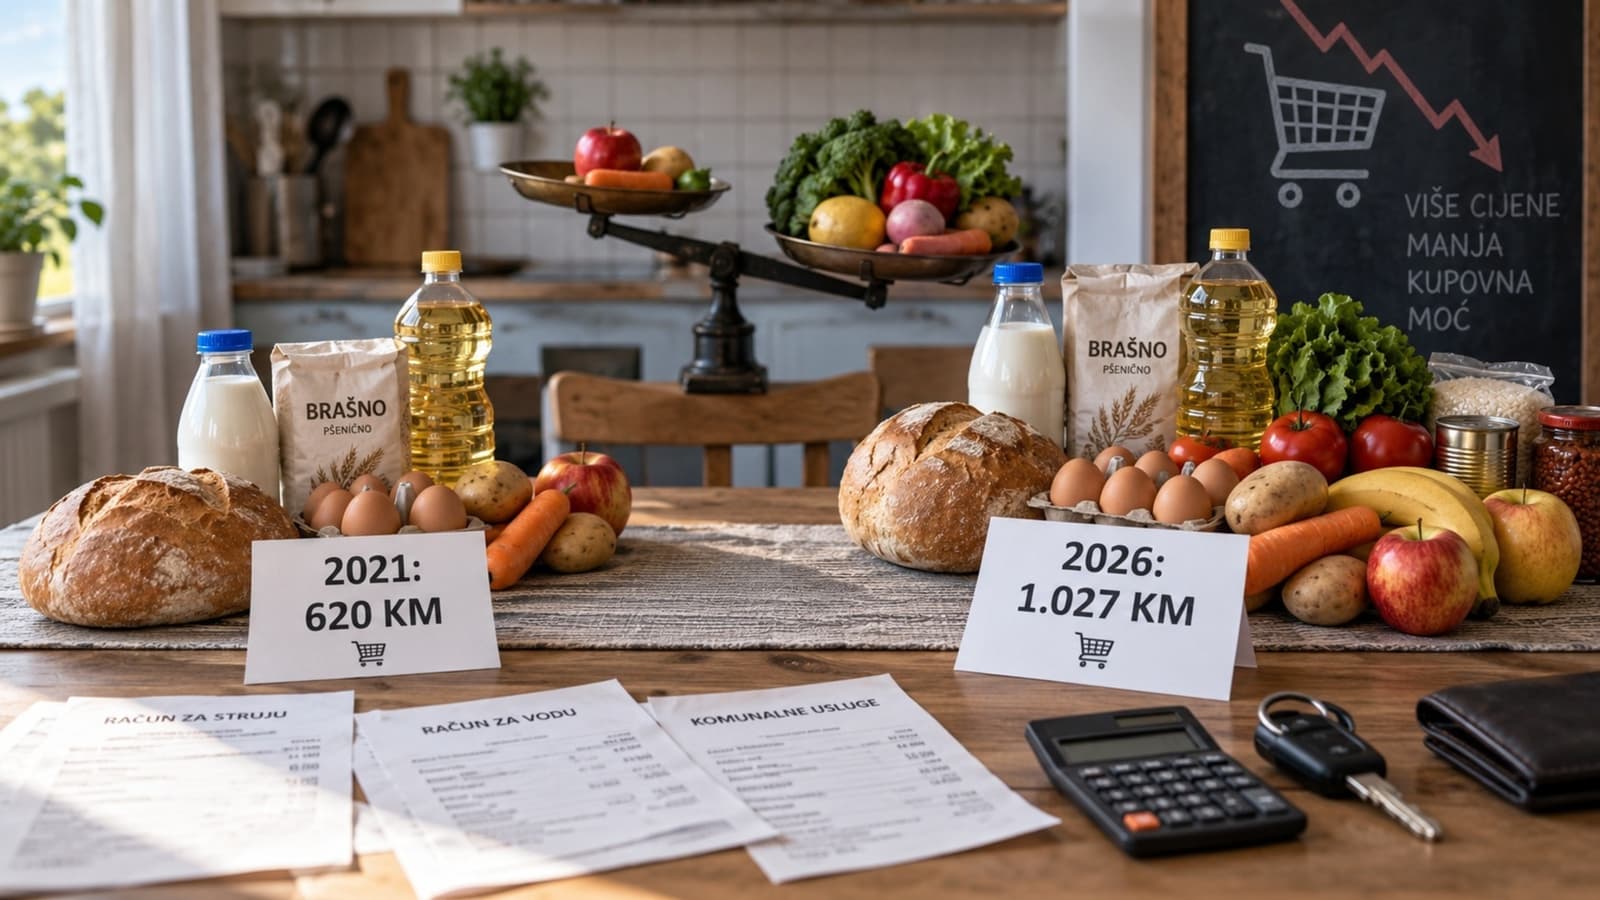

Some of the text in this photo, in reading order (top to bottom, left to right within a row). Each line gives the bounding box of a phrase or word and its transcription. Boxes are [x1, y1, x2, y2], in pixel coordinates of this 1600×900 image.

[1405, 186, 1561, 218] VIŠE CIJENE
[1407, 231, 1503, 257] MANJA
[1407, 269, 1534, 294] KUPOVNA
[1408, 299, 1471, 331] MOĆ
[1088, 336, 1167, 358] BRAŠNO
[1103, 363, 1151, 375] PŠENIČNO
[306, 397, 387, 420] BRAŠNO
[323, 423, 372, 436] PŠENIČNO
[324, 554, 421, 586] 2021:
[1062, 541, 1165, 577] 2026:
[305, 597, 442, 632] 620 KM
[1017, 583, 1195, 626] 1.027 KM
[103, 710, 288, 725] RAČUN ZA STRUJU
[421, 707, 577, 736] RAČUN ZA VODU
[690, 698, 880, 727] KOMUNALNE USLUGE
